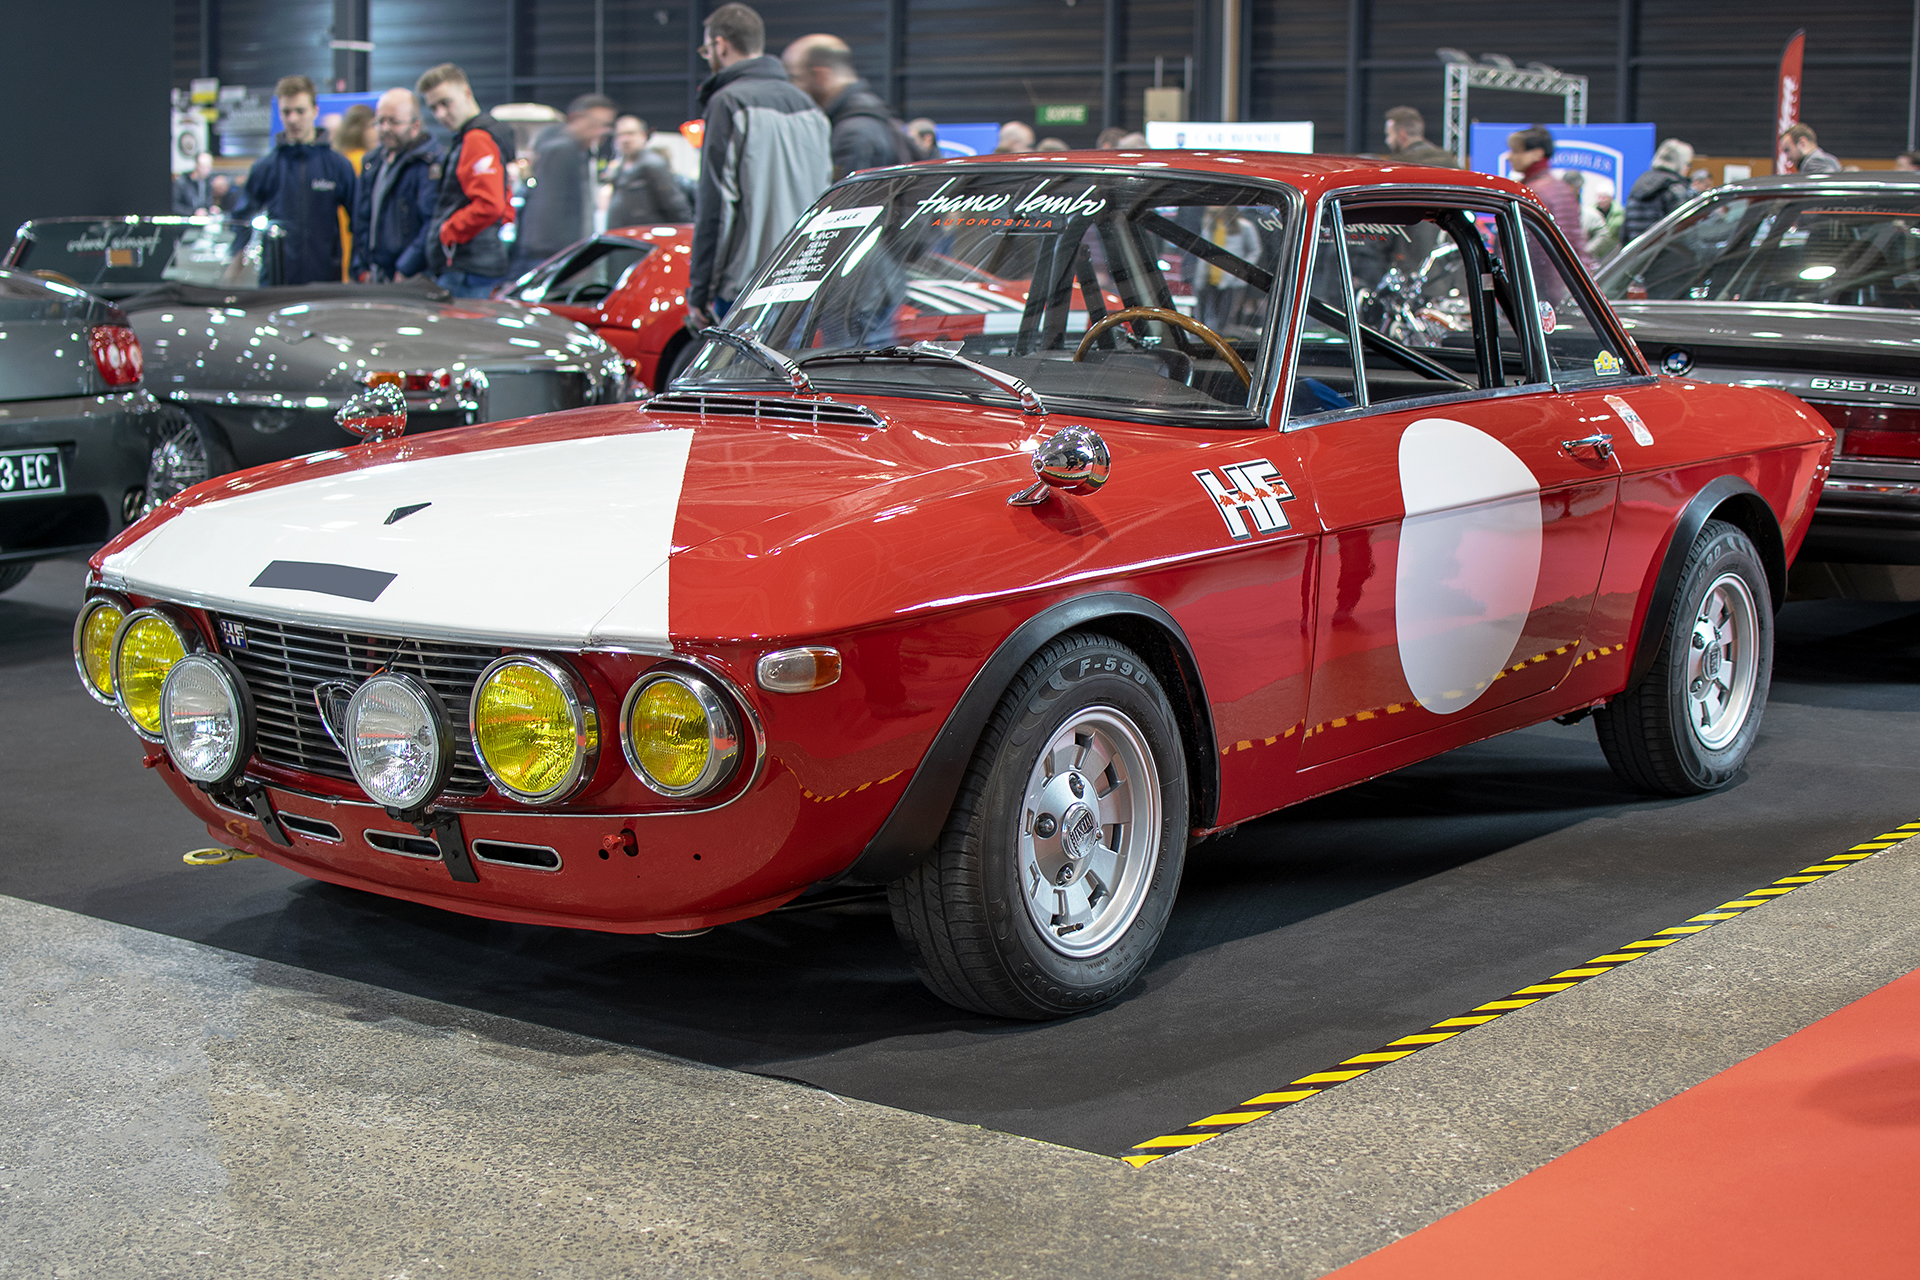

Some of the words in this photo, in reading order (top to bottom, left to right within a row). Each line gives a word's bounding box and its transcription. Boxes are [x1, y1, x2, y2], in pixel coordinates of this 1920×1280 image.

[1044, 107, 1085, 122] SORTIE
[900, 177, 1010, 230] franco
[1014, 178, 1106, 216] lembo
[834, 212, 861, 223] SALE
[931, 218, 1053, 228] AUTOMOBILIA
[1811, 378, 1867, 391] 635
[1192, 458, 1297, 541] HF
[221, 621, 246, 646] HF
[1079, 657, 1147, 685] F-590
